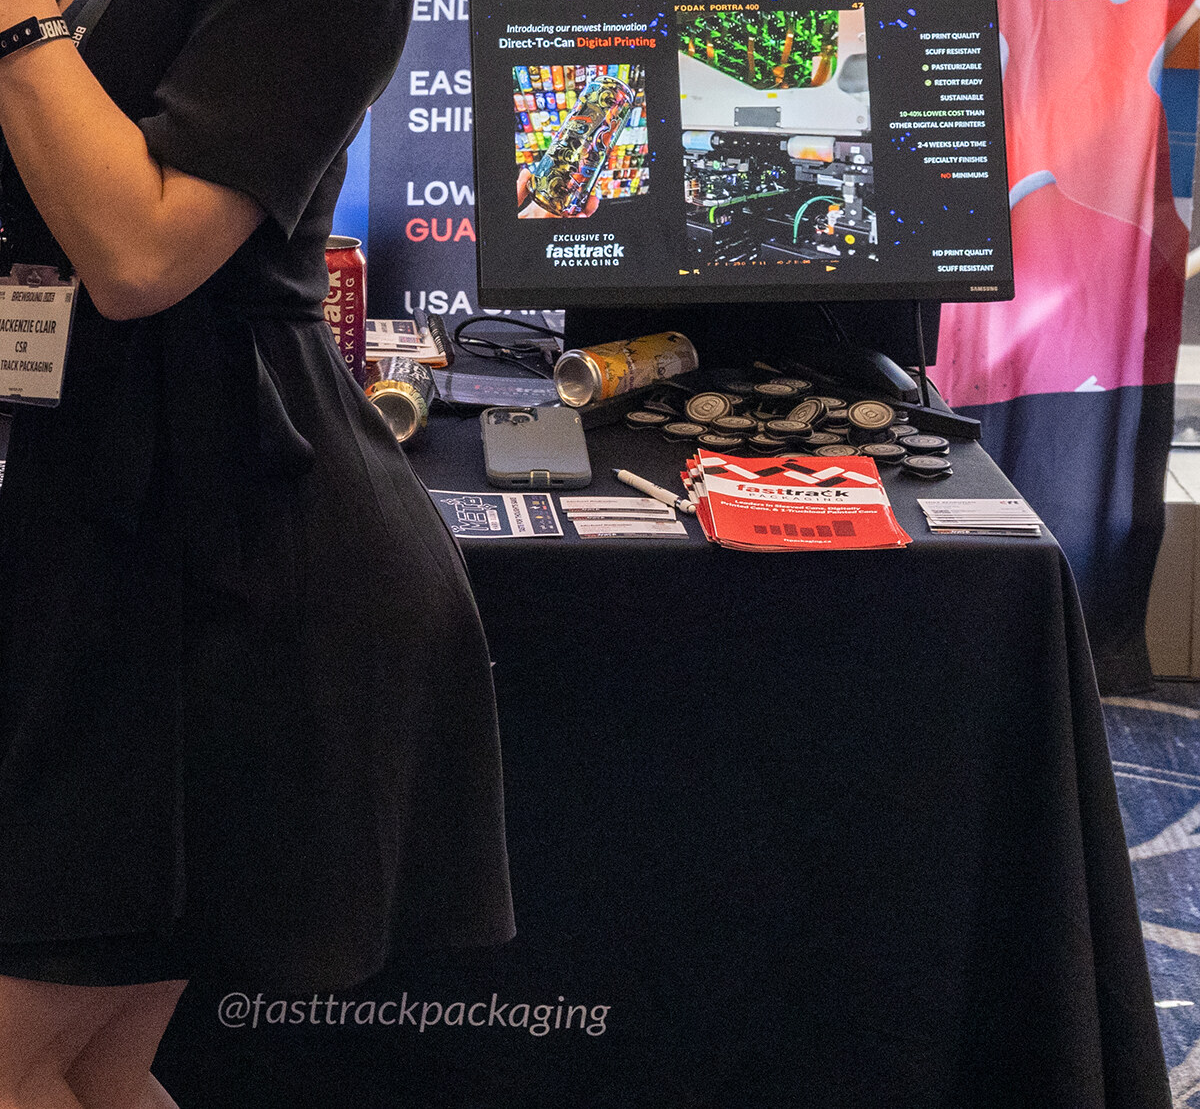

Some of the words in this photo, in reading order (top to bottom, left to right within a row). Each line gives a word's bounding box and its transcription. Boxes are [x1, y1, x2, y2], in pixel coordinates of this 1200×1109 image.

[674, 4, 706, 12] KODAK
[709, 3, 744, 12] PORTRA
[506, 24, 554, 35] Introducing
[555, 25, 571, 33] our
[571, 24, 602, 33] newest
[602, 22, 648, 32] innovation
[951, 32, 981, 40] QUALITY
[498, 37, 575, 49] Direct-To-Can
[576, 37, 612, 49] Digital
[613, 36, 657, 49] Printing
[925, 48, 946, 56] SCUFF
[931, 63, 983, 71] PASTEURIZABLE
[960, 78, 983, 86] READY
[924, 156, 958, 164] SPECIALTY
[958, 155, 988, 163] FINISHES
[553, 233, 600, 242] EXCLUSIVE
[602, 233, 615, 241] TO
[545, 242, 625, 258] fasttrack
[963, 248, 994, 257] QUALITY
[554, 258, 620, 267] PACKAGING
[937, 264, 959, 273] SCUFF
[958, 264, 995, 272] RESISTANT
[405, 290, 474, 316] USA
[35, 320, 57, 334] CLAIR
[14, 341, 28, 353] CSR
[0, 359, 19, 371] TRACK
[735, 483, 850, 498] fasttrack
[217, 991, 612, 1037] @fasttrackpackaging
